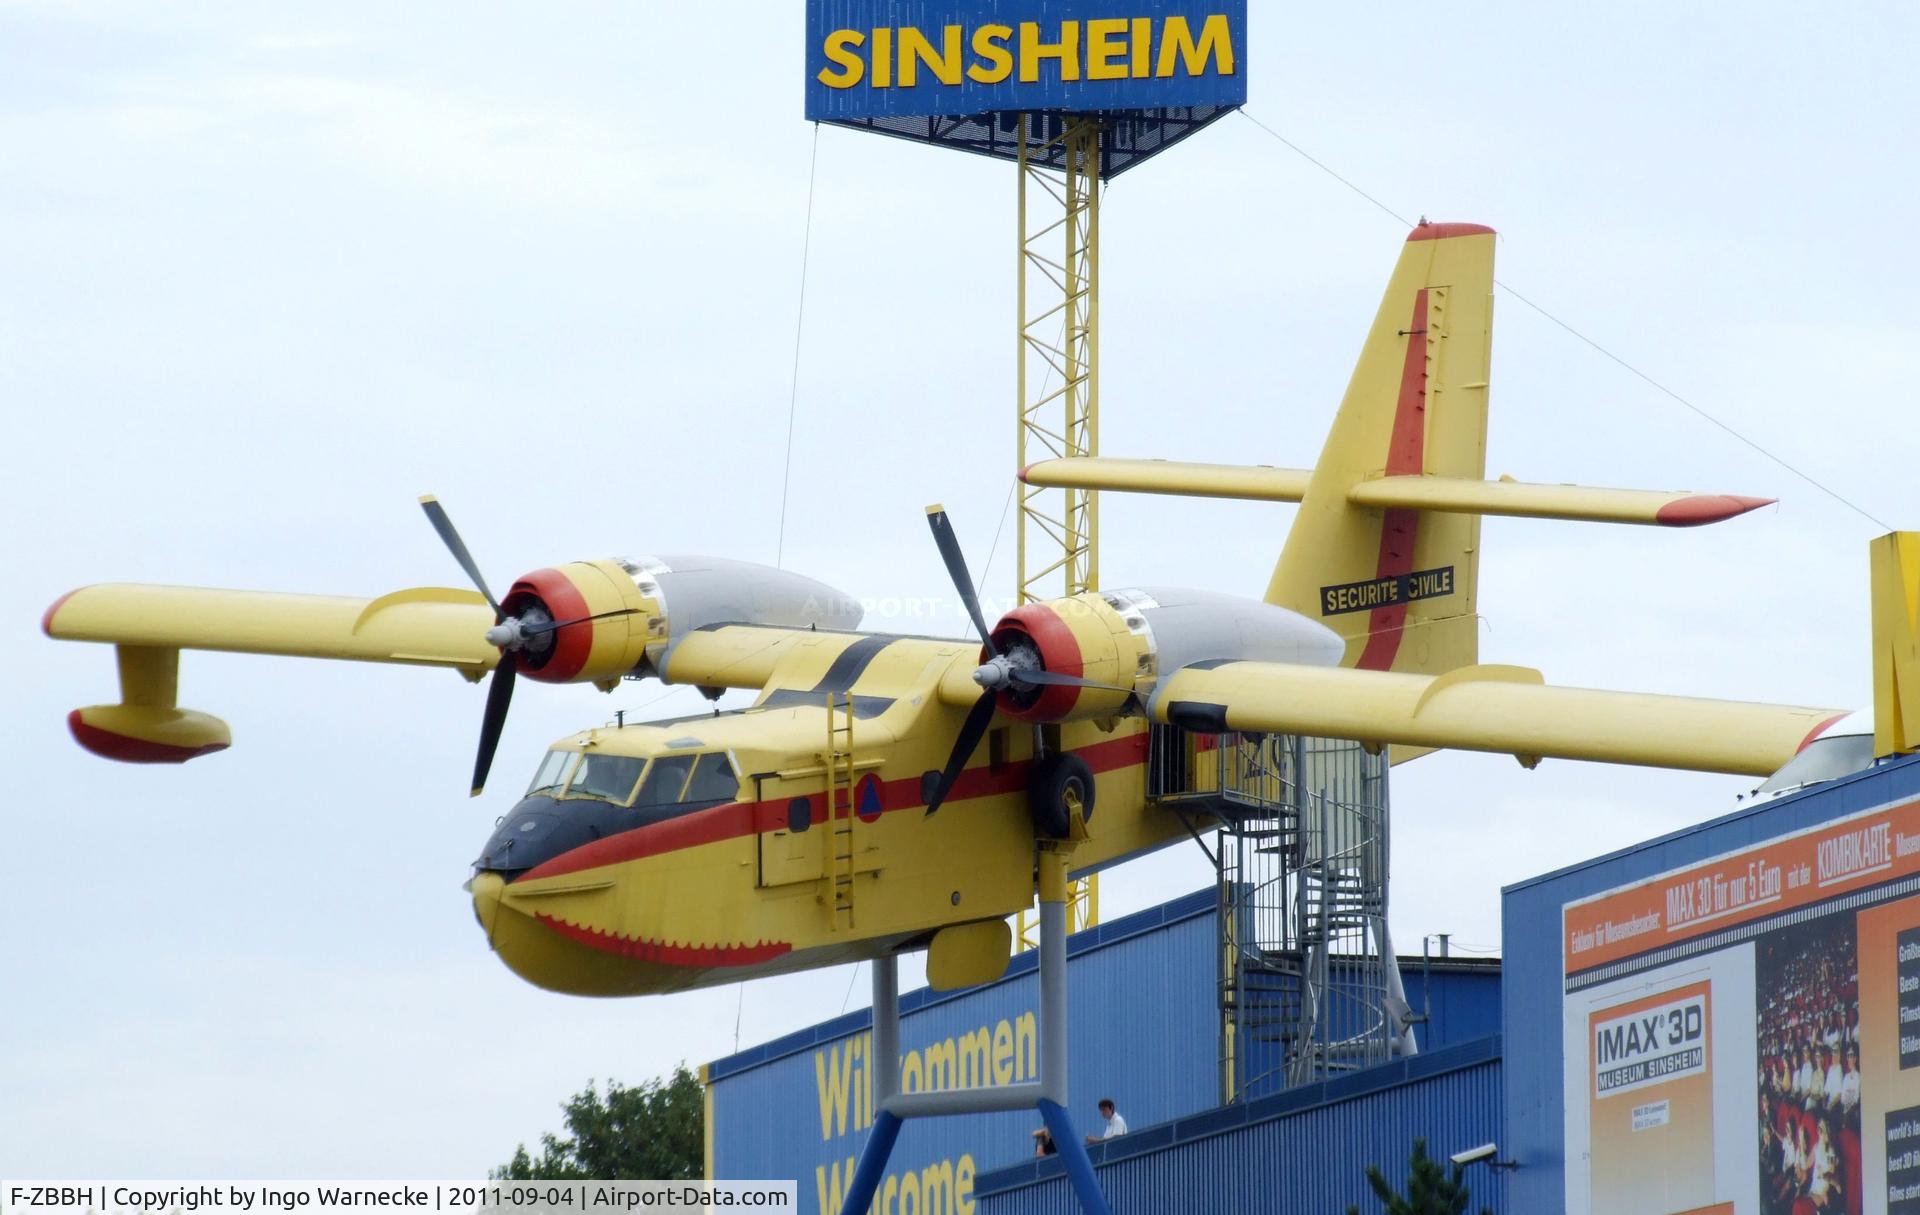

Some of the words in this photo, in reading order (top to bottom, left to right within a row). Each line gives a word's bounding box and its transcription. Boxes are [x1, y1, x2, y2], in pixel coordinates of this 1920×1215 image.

[817, 14, 1235, 89] SINSHEIM
[1326, 580, 1398, 611] SECURITE
[1408, 571, 1450, 598] CIVILE
[1666, 881, 1695, 925] IMAX
[1698, 876, 1712, 916] 3D
[1714, 872, 1729, 911] für
[1731, 876, 1747, 907] nur
[1749, 861, 1757, 900] 5
[1759, 860, 1781, 897] Euro
[1817, 822, 1891, 880] KOMBIKARTE
[1900, 976, 1919, 993] Beste
[1668, 1004, 1702, 1045] 3D
[816, 1011, 1037, 1141] Wilommen
[1598, 1066, 1645, 1090] MUSEUM
[1649, 1050, 1702, 1077] SINSHEIM
[1888, 1121, 1912, 1141] world's
[1888, 1156, 1902, 1172] best
[1903, 1152, 1912, 1169] 3D
[1889, 1186, 1905, 1203] films
